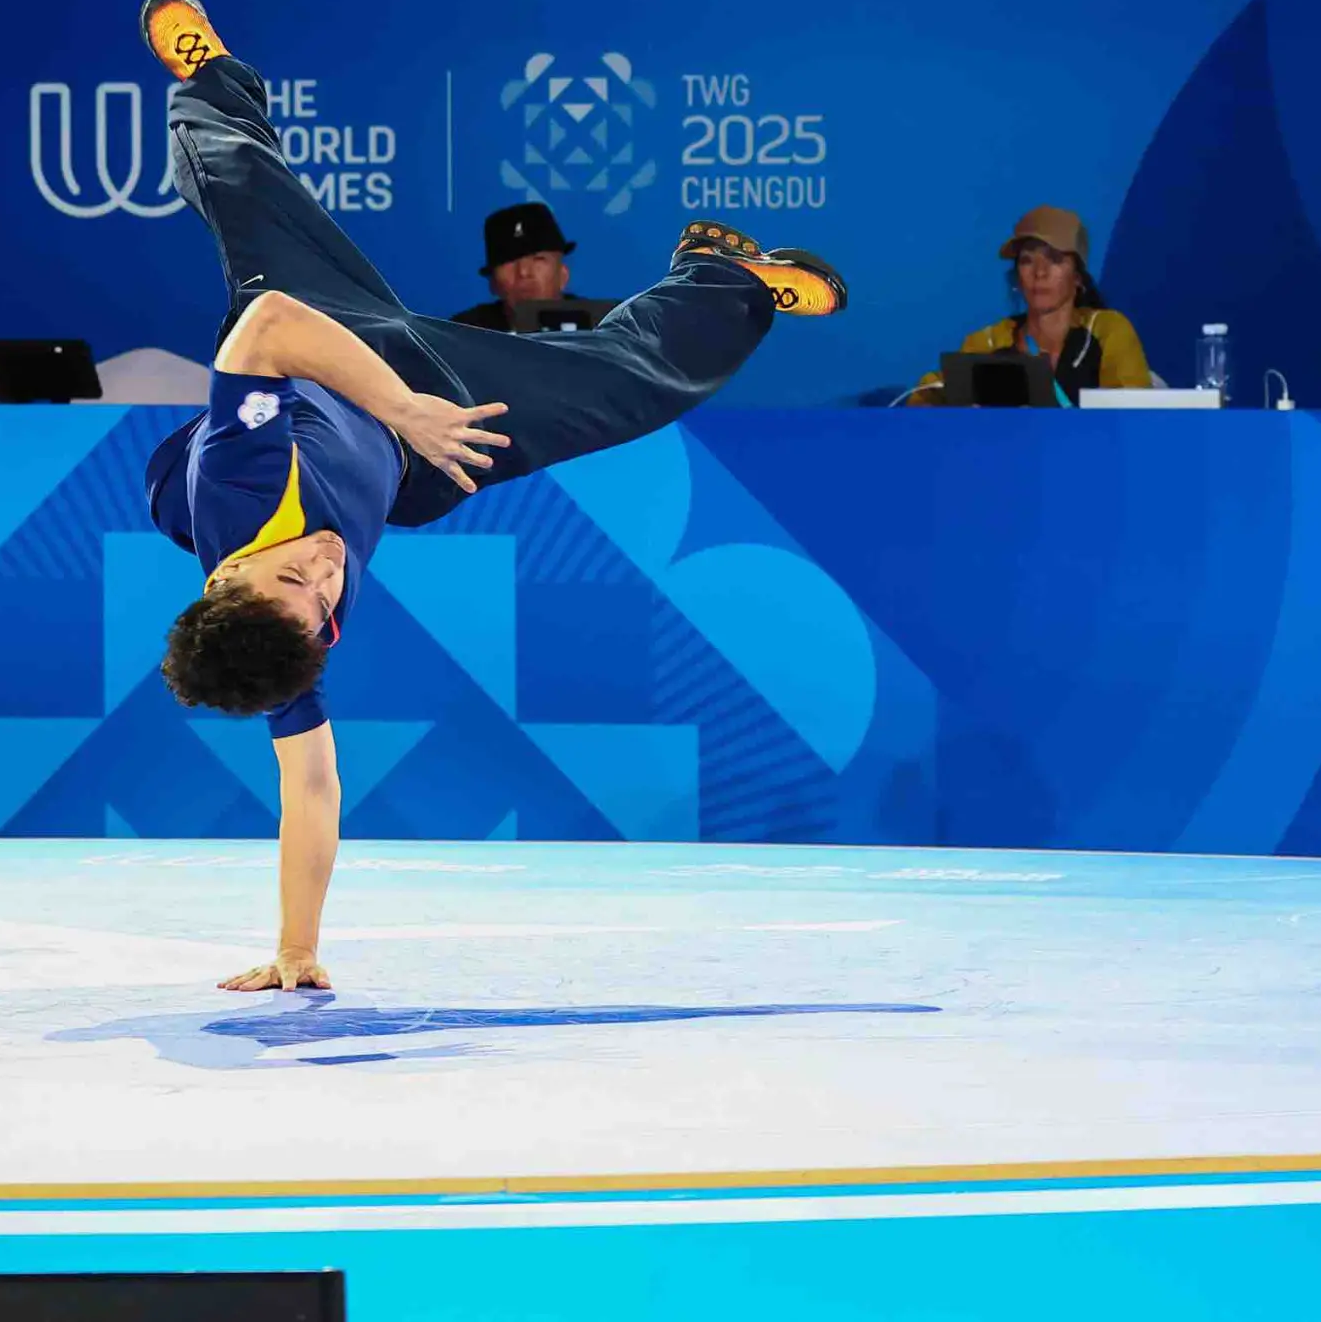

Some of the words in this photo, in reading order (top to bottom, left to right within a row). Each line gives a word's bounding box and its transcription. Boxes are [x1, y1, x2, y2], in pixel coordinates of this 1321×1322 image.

[264, 79, 318, 118] HE
[682, 76, 748, 105] TWG
[276, 125, 397, 165] ORLD
[682, 116, 825, 165] 2025
[298, 172, 394, 212] MES
[683, 177, 825, 208] CHENGDU
